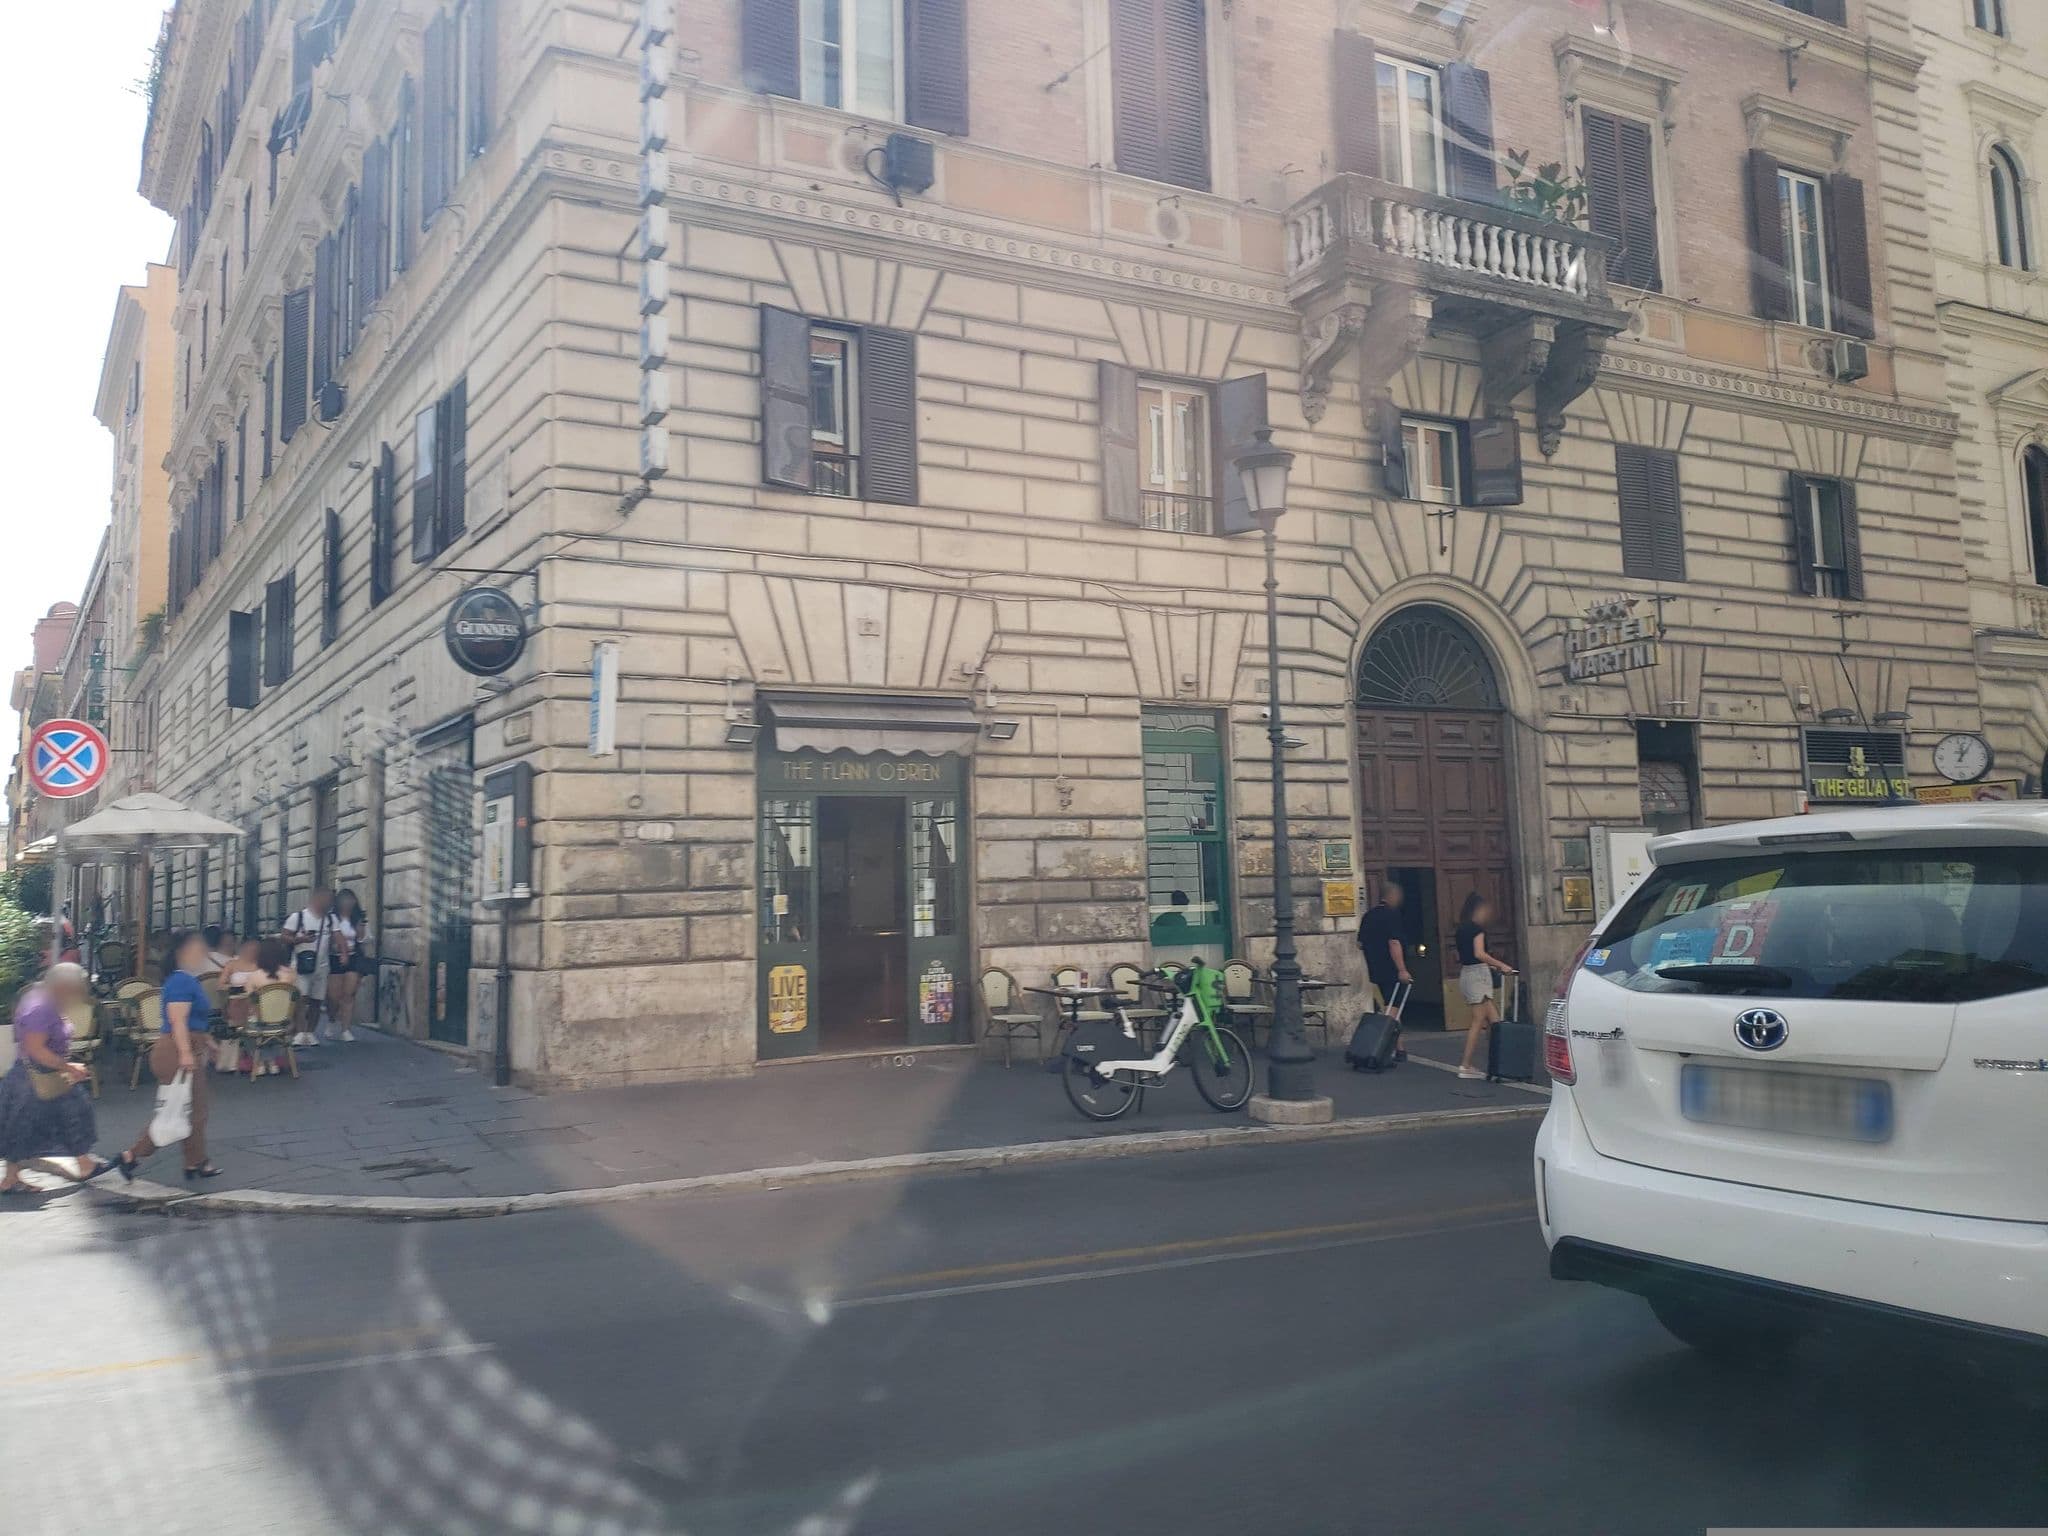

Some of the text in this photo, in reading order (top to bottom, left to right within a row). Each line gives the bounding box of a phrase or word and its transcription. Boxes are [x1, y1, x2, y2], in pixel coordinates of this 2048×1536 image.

[1566, 616, 1656, 654] HOTEL
[1569, 643, 1658, 679] MARTINI
[783, 761, 813, 780] THE
[822, 762, 870, 780] FLANN
[1814, 779, 1845, 797] THE
[1673, 886, 1701, 914] 11
[1722, 924, 1754, 957] D
[770, 975, 805, 996] LIVE
[770, 997, 805, 1012] MUSIC
